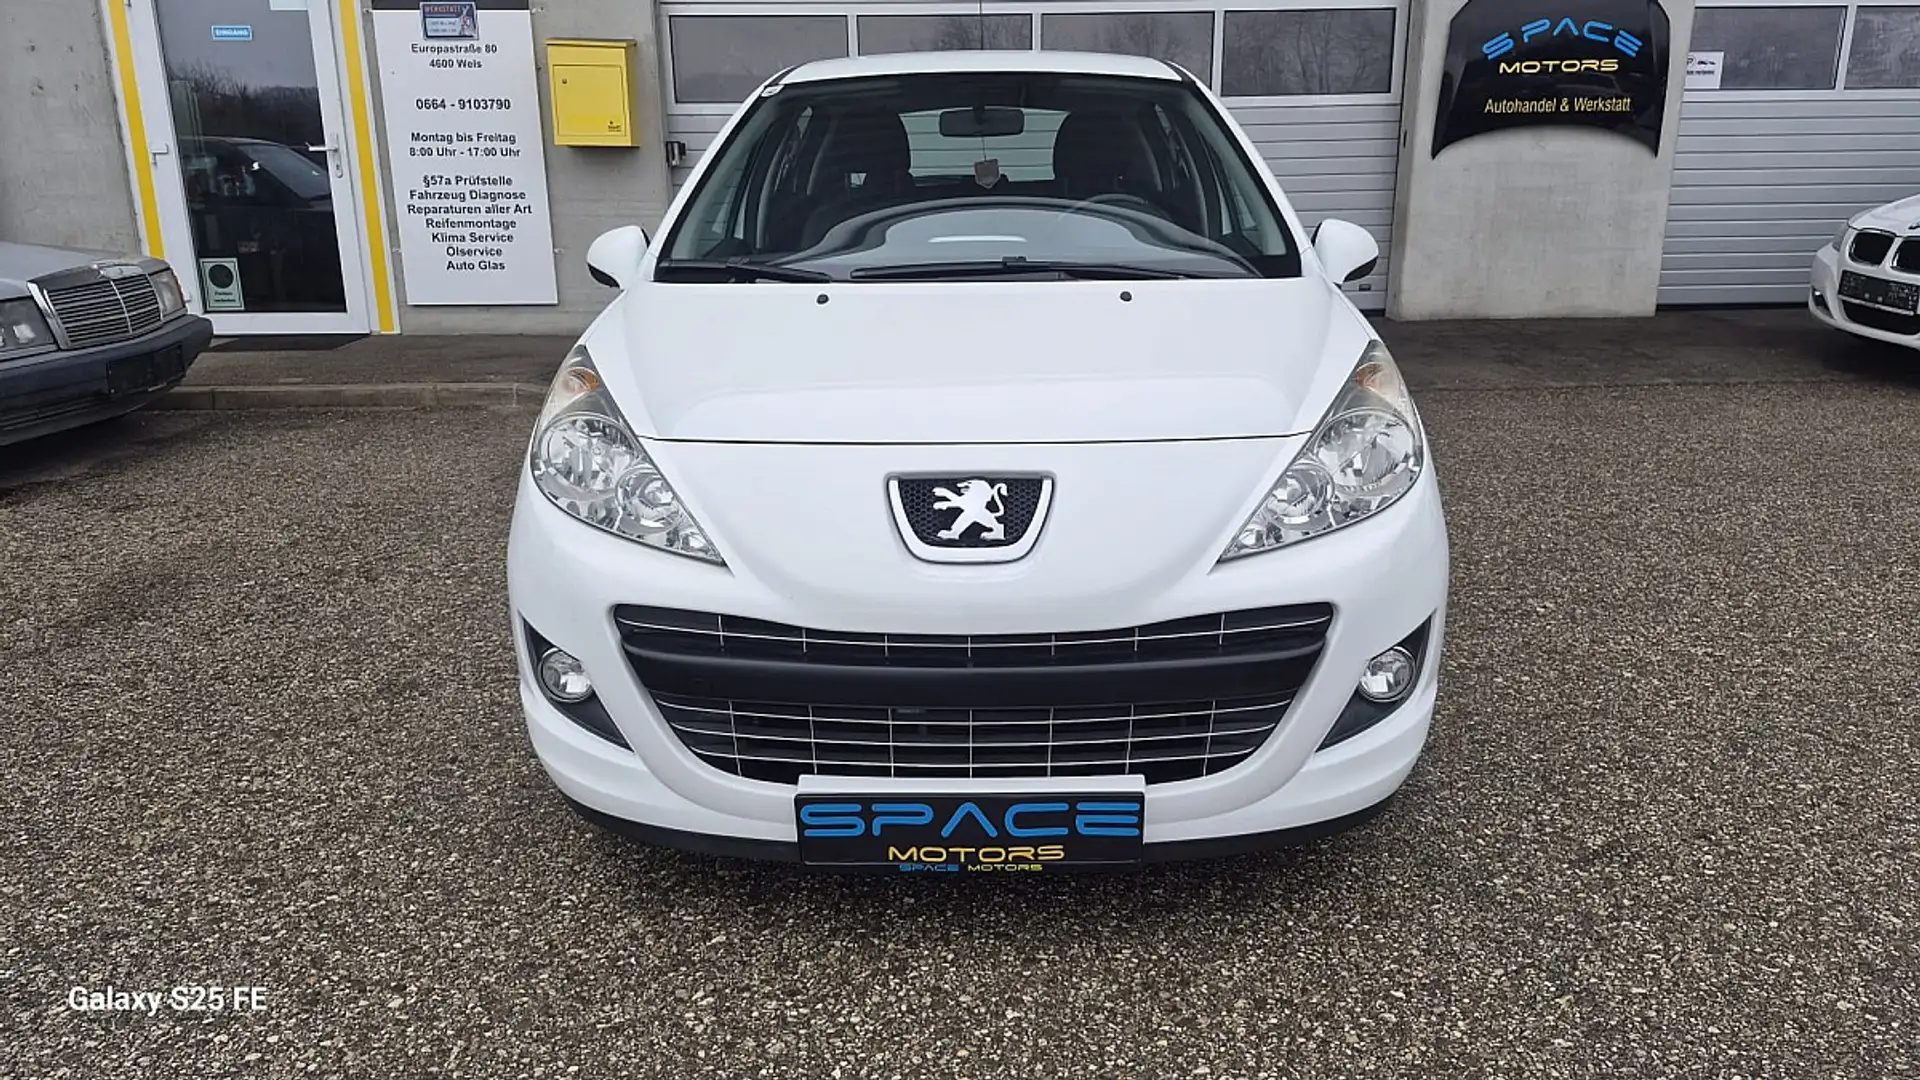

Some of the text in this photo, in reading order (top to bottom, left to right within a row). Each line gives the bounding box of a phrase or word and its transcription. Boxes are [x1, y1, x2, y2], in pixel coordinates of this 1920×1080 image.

[1482, 17, 1643, 60] SPACE
[411, 43, 497, 54] Europastraße 80
[429, 59, 454, 68] 4600
[1499, 59, 1619, 74] MOTORS
[415, 99, 447, 110] 0664
[458, 99, 511, 110] 9103790
[1484, 97, 1632, 114] Autohandel & Werkstatt
[411, 132, 516, 144] Montag bis Freitag
[409, 147, 433, 157] 8:00
[436, 147, 457, 157] Uhr
[468, 147, 497, 157] 17:00
[500, 147, 521, 157] Uhr
[423, 175, 513, 188] §57a Prüfstelle
[409, 190, 526, 202] Fahrzeug Diagnose
[407, 204, 532, 216] Reparaturen aller Art
[426, 218, 517, 230] Reifenmontage
[432, 232, 514, 243] Klima Service
[446, 260, 505, 271] Auto Glas
[800, 802, 1141, 837] SPACE
[888, 845, 1065, 862] MOTORS
[900, 864, 1043, 872] SPACE MOTORS
